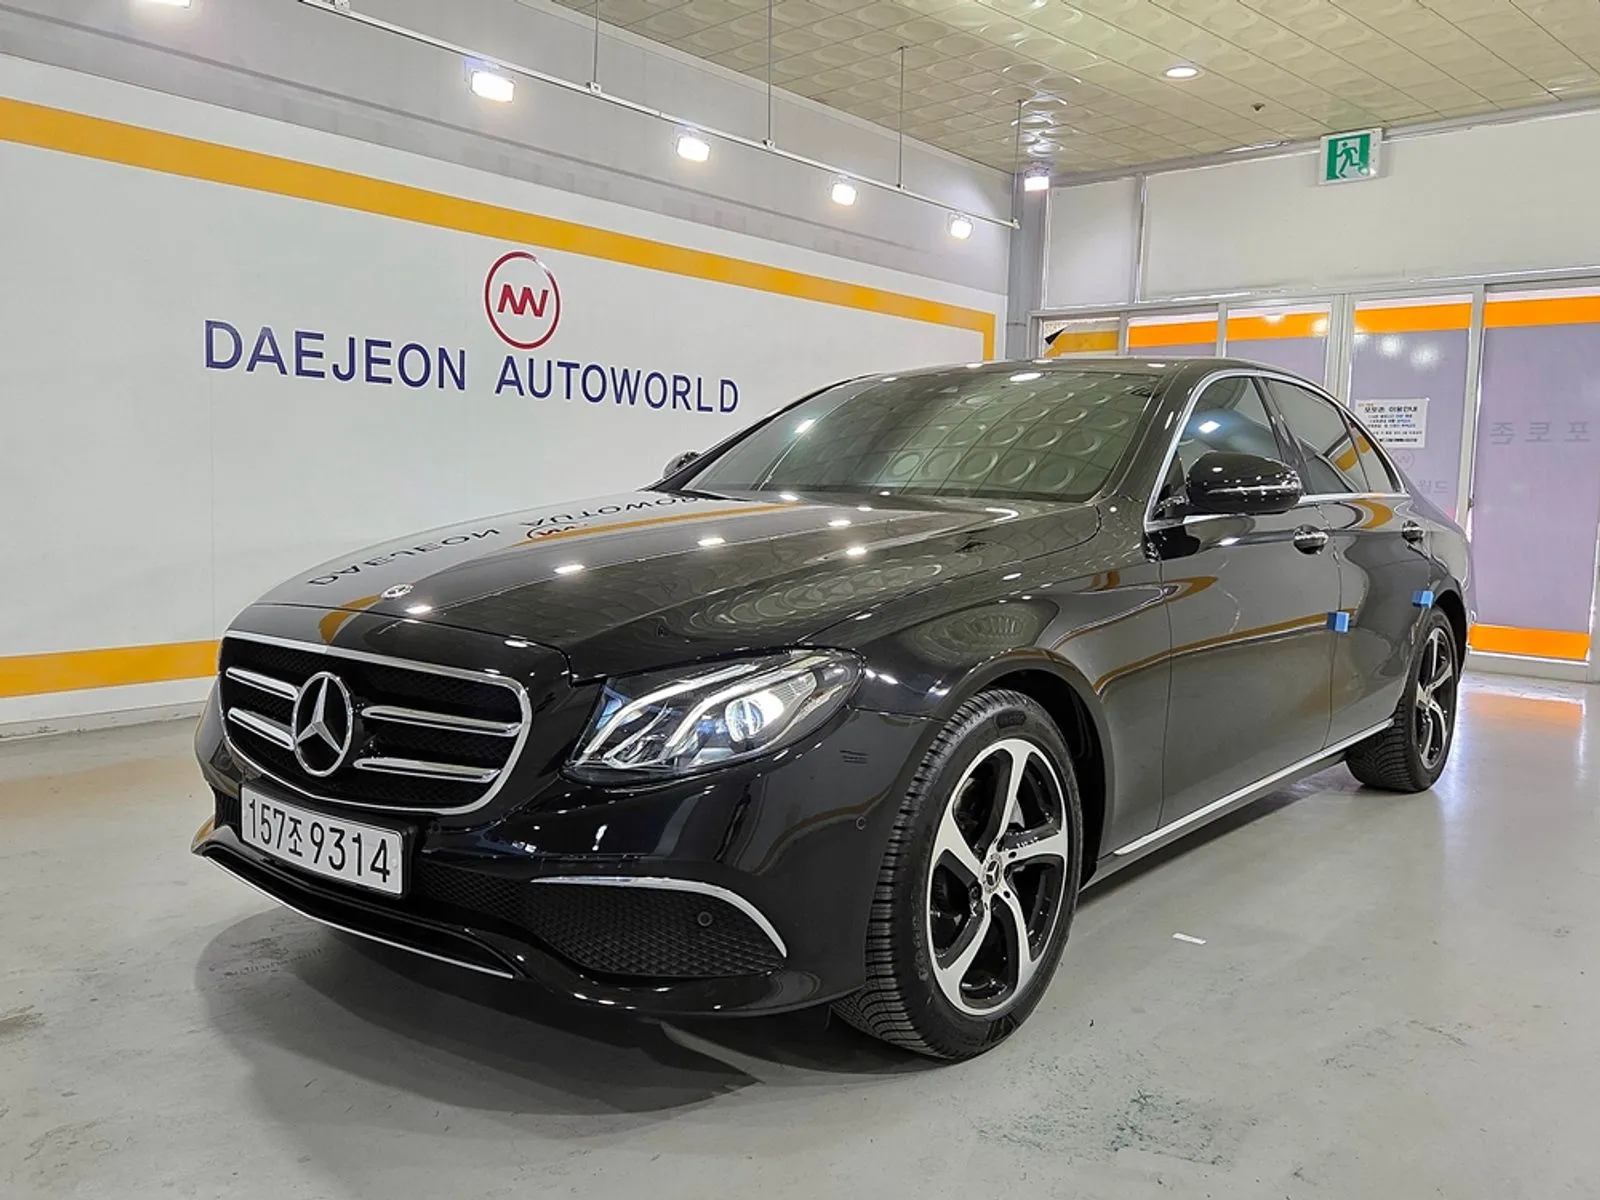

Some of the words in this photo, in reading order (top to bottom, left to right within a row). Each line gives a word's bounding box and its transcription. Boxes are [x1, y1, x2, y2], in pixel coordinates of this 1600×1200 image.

[204, 319, 466, 390] DAEJEON
[494, 355, 740, 413] AUTOWORLD
[249, 798, 391, 883] 157조9314
